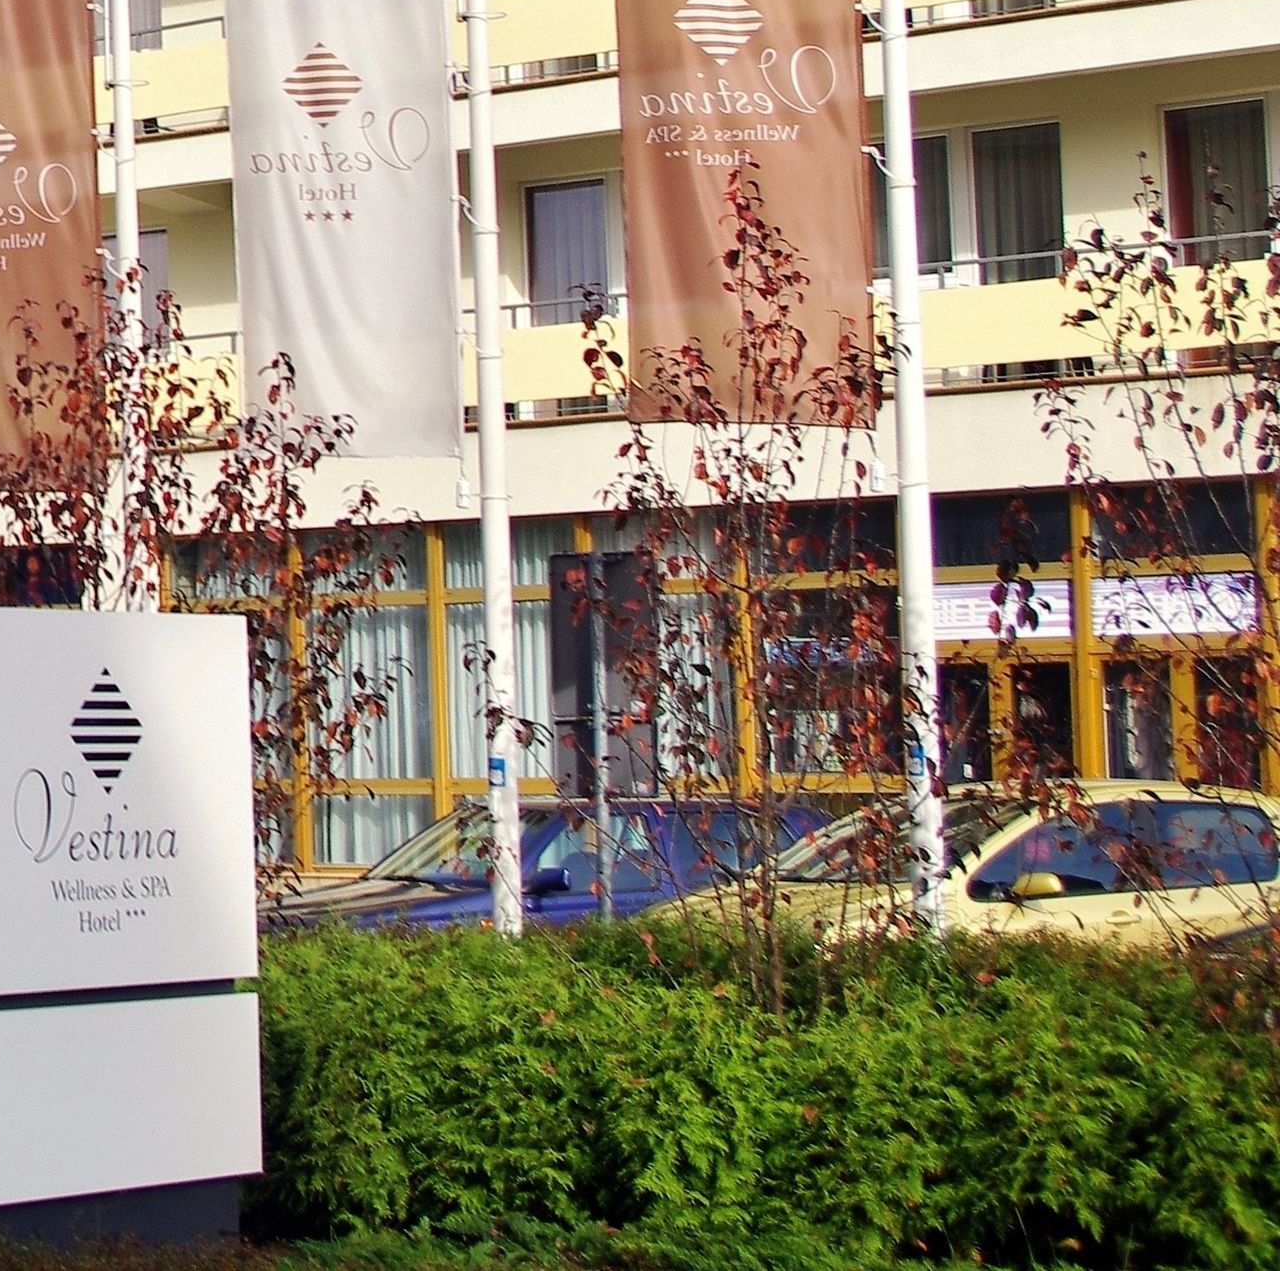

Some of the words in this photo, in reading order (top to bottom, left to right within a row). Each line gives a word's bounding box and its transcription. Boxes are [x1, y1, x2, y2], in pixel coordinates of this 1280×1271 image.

[13, 767, 179, 864] Vestina
[50, 878, 117, 903] Wellness
[122, 880, 137, 900] &
[140, 876, 171, 898] SPA
[79, 910, 122, 934] Hotel
